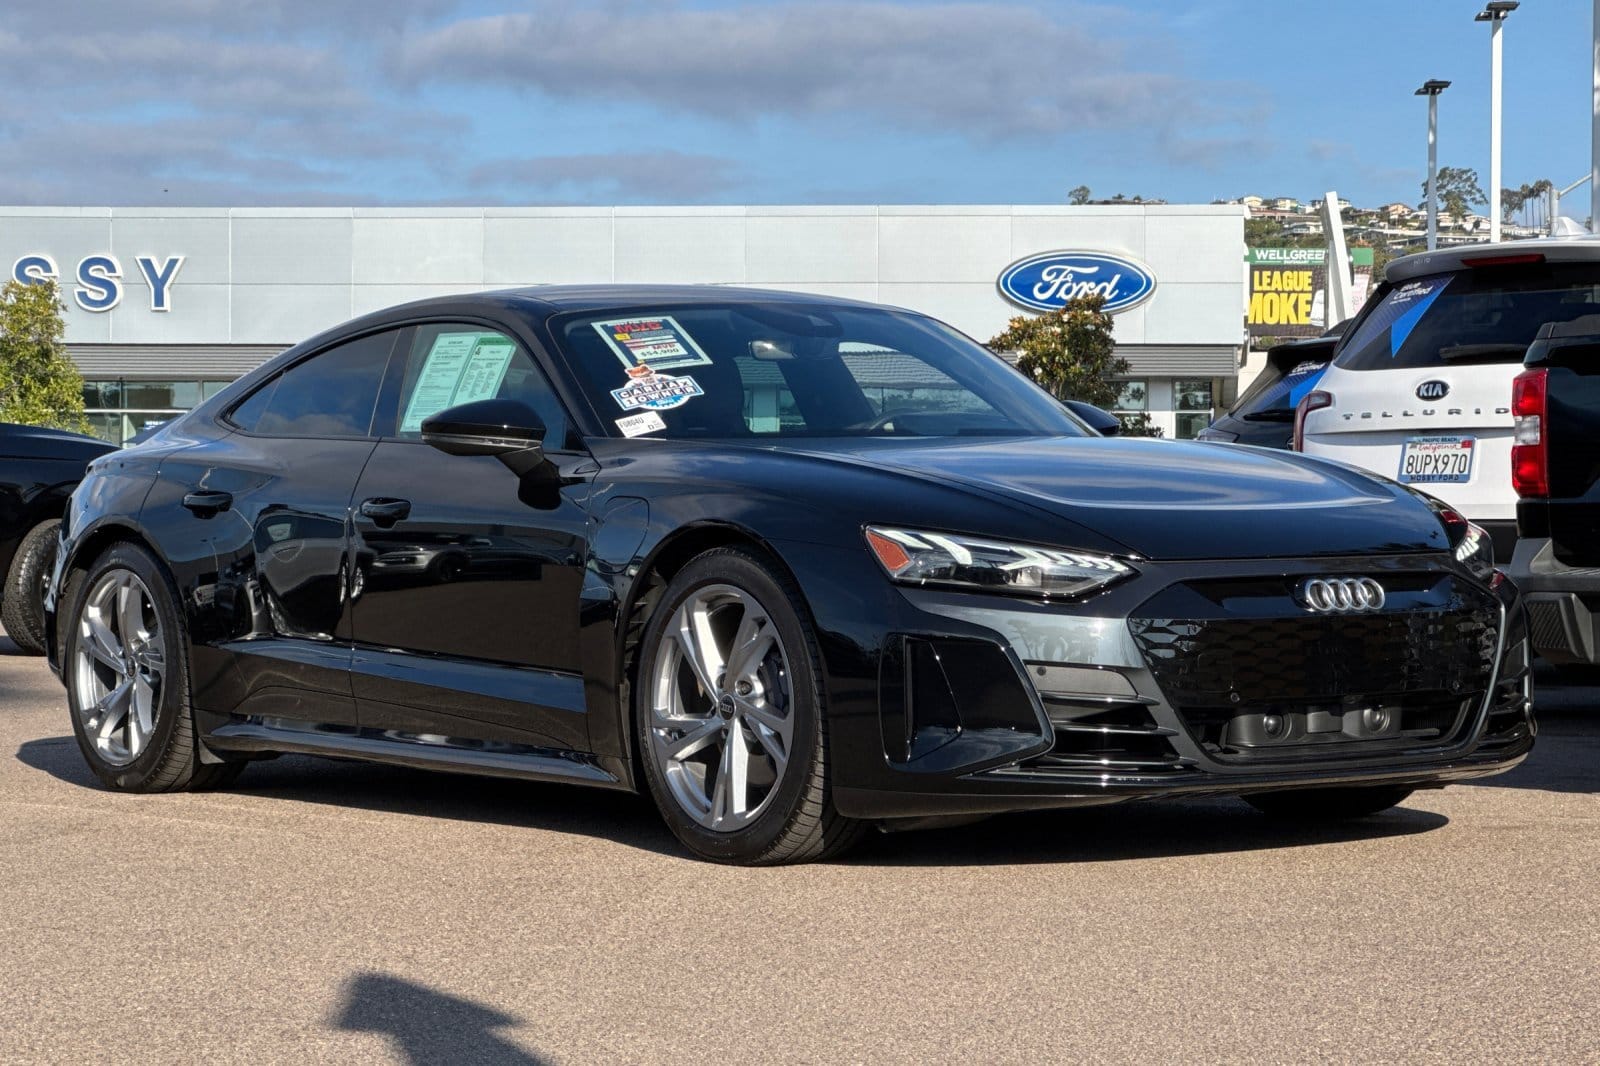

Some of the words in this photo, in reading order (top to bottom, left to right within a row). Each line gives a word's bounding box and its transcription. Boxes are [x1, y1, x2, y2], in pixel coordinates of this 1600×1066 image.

[1033, 264, 1122, 300] Ford
[1253, 270, 1313, 291] LEAGUE
[619, 380, 691, 399] CARFAX
[637, 386, 696, 403] OWNER
[1419, 384, 1443, 397] KIA
[1405, 453, 1468, 474] 8UPX970
